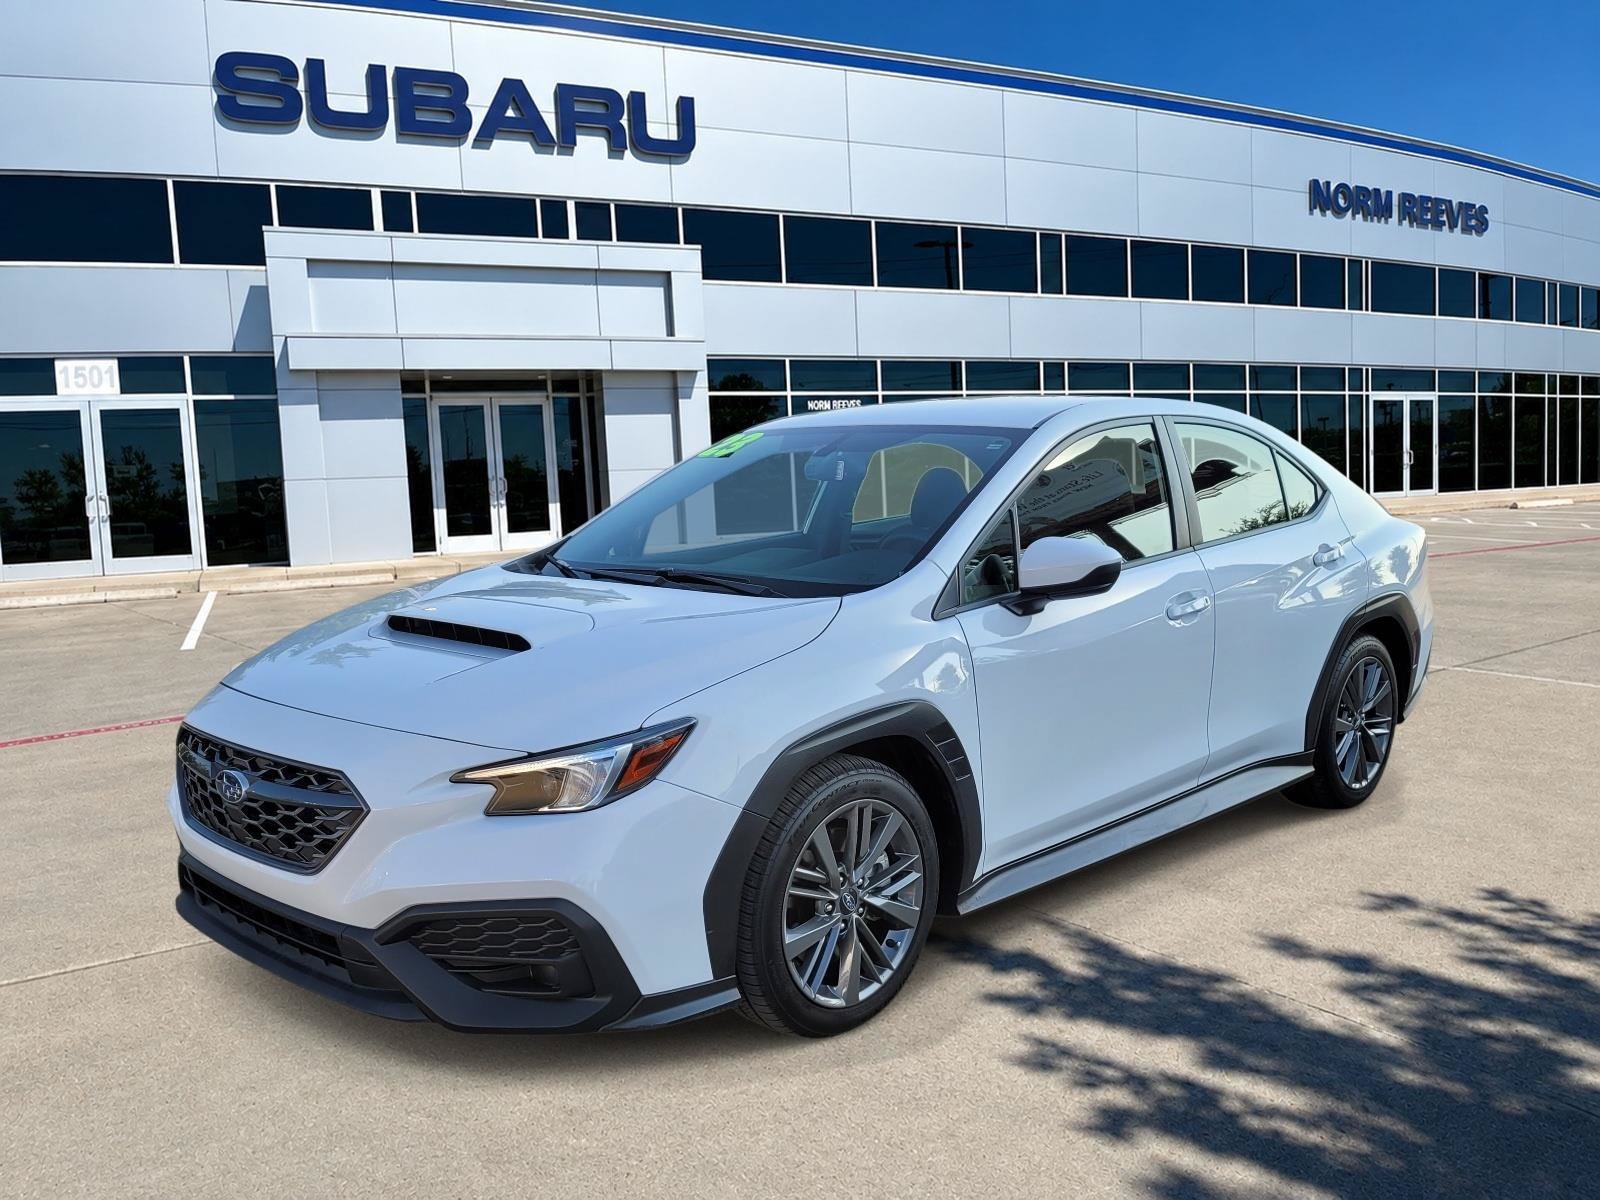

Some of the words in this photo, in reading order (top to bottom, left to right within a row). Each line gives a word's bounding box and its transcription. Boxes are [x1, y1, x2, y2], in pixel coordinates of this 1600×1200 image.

[215, 51, 696, 157] SUBARU
[1309, 179, 1393, 221] NORM
[1398, 192, 1489, 236] REEVES
[59, 364, 115, 389] 1501
[807, 400, 831, 411] NORM
[832, 399, 862, 410] REEVES
